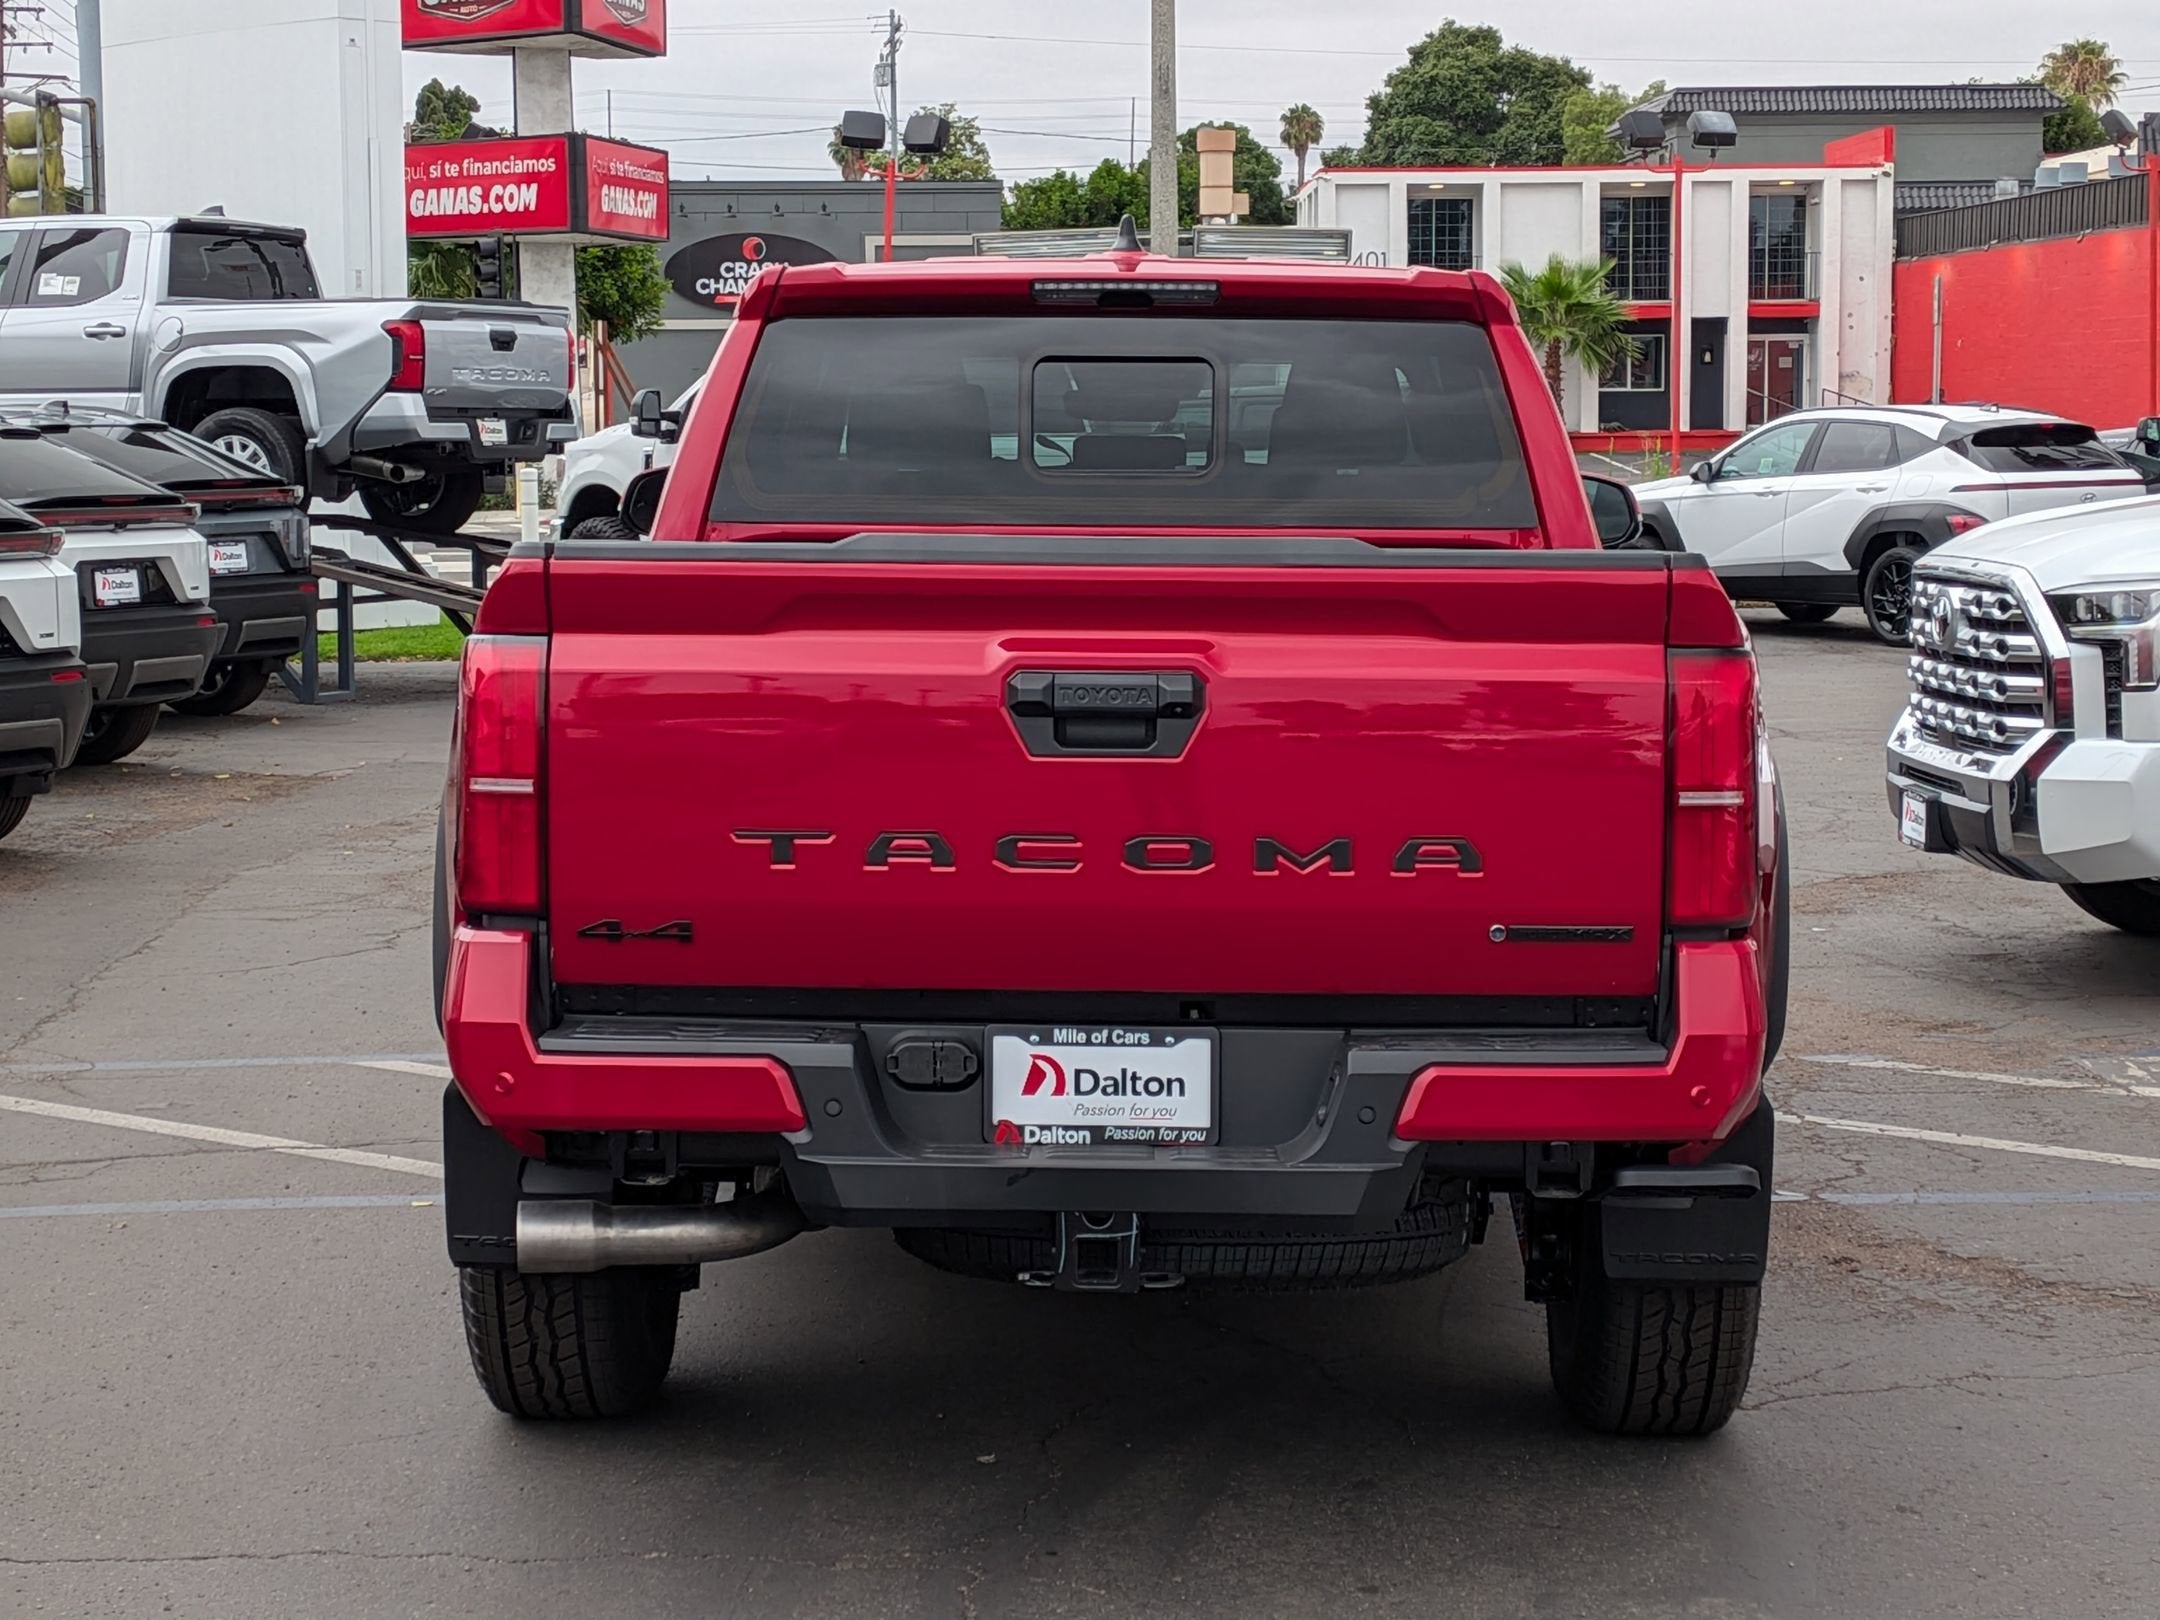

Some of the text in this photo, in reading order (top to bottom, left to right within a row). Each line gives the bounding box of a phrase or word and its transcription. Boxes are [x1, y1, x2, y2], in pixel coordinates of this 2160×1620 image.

[404, 155, 556, 182] quí, sí te financiamos
[409, 182, 538, 217] GANAS.COM
[1059, 687, 1152, 704] TOYOTA
[729, 828, 1485, 877] TACOMA
[1053, 1028, 1150, 1045] Mile of Cars
[1074, 1068, 1186, 1097] Dalton
[1073, 1103, 1178, 1119] Passion for you
[1024, 1126, 1091, 1145] Dalton
[1104, 1126, 1206, 1143] Passion for you
